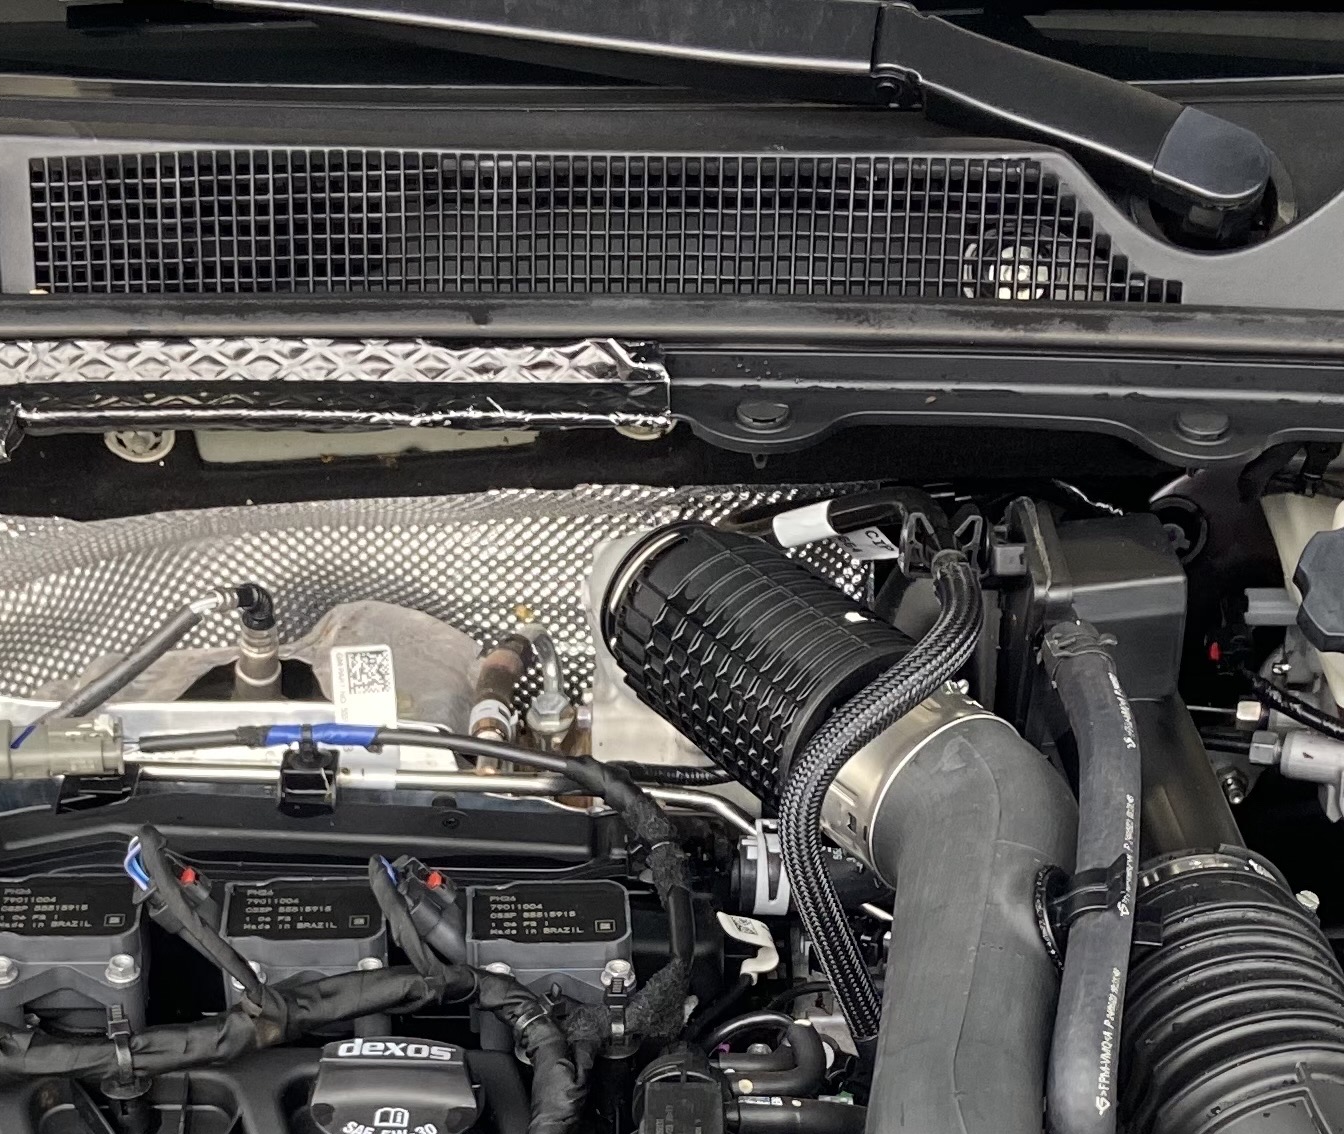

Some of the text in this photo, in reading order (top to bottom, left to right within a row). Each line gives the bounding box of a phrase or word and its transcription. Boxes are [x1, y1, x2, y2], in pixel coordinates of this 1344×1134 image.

[51, 920, 92, 928] BRAZIL
[243, 922, 271, 930] Made
[337, 1037, 452, 1061] dexos
